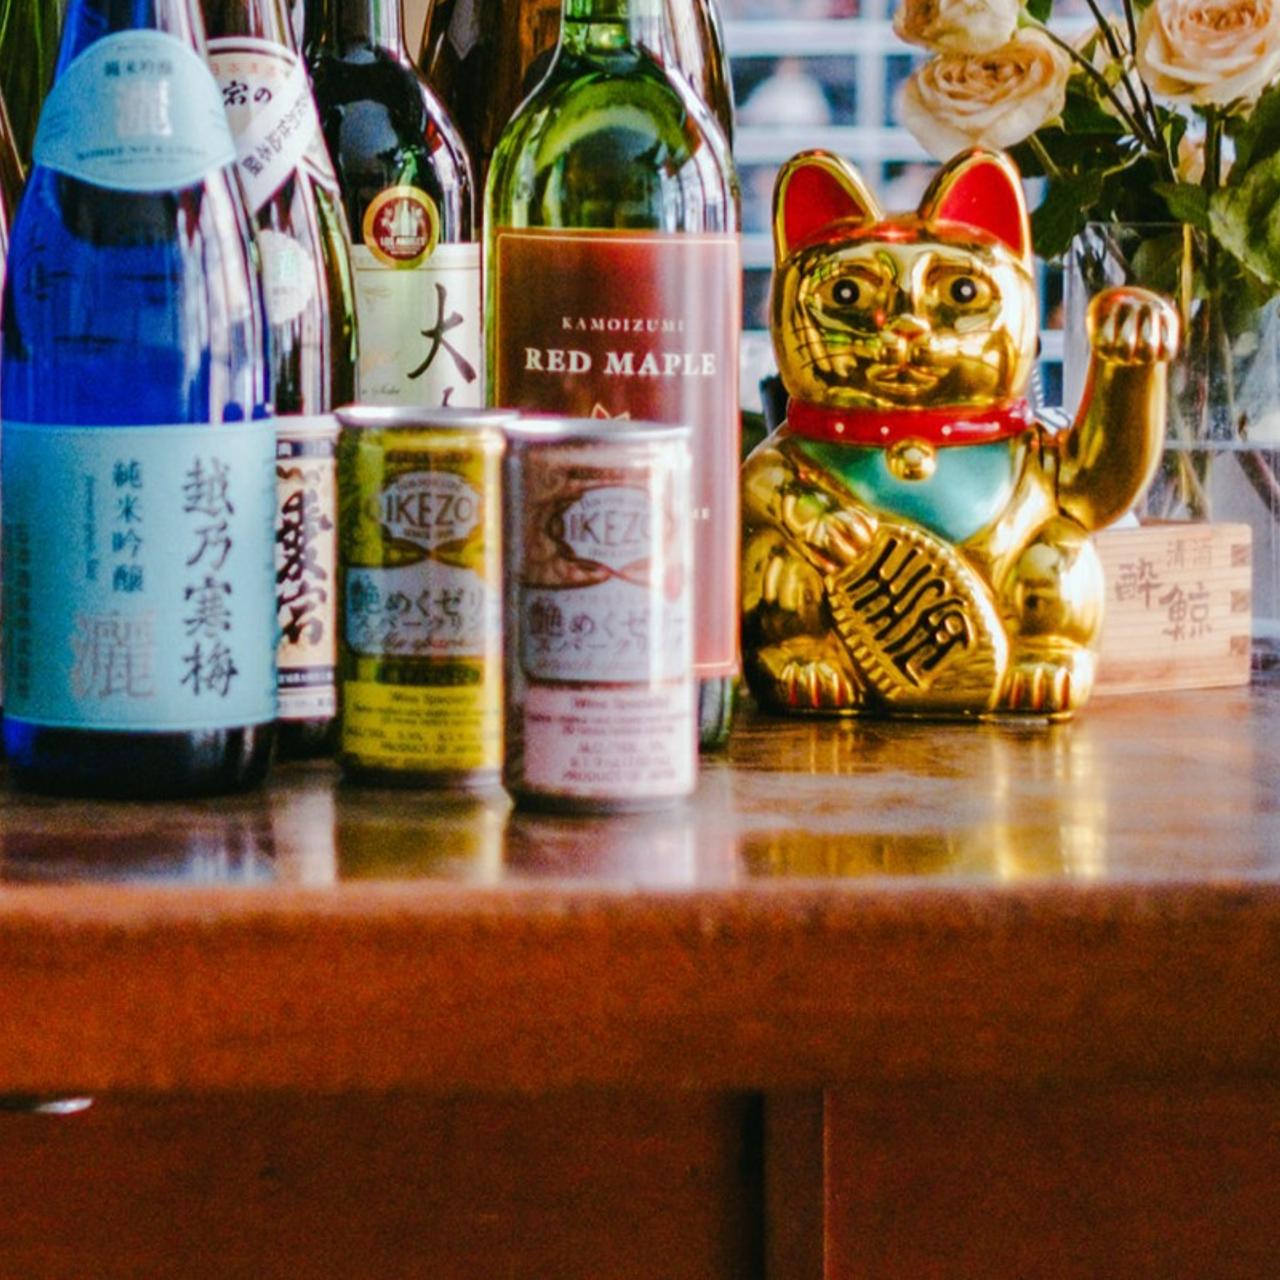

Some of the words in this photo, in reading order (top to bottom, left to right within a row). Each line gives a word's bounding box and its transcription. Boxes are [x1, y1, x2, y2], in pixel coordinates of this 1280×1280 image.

[407, 282, 477, 407] 大
[525, 347, 592, 373] RED
[603, 351, 718, 376] MAPLE
[561, 317, 685, 332] KAMOIZUMI
[111, 459, 144, 594] 純米吟醸
[386, 492, 474, 526] IKEZO
[180, 457, 239, 699] 越乃寒梅
